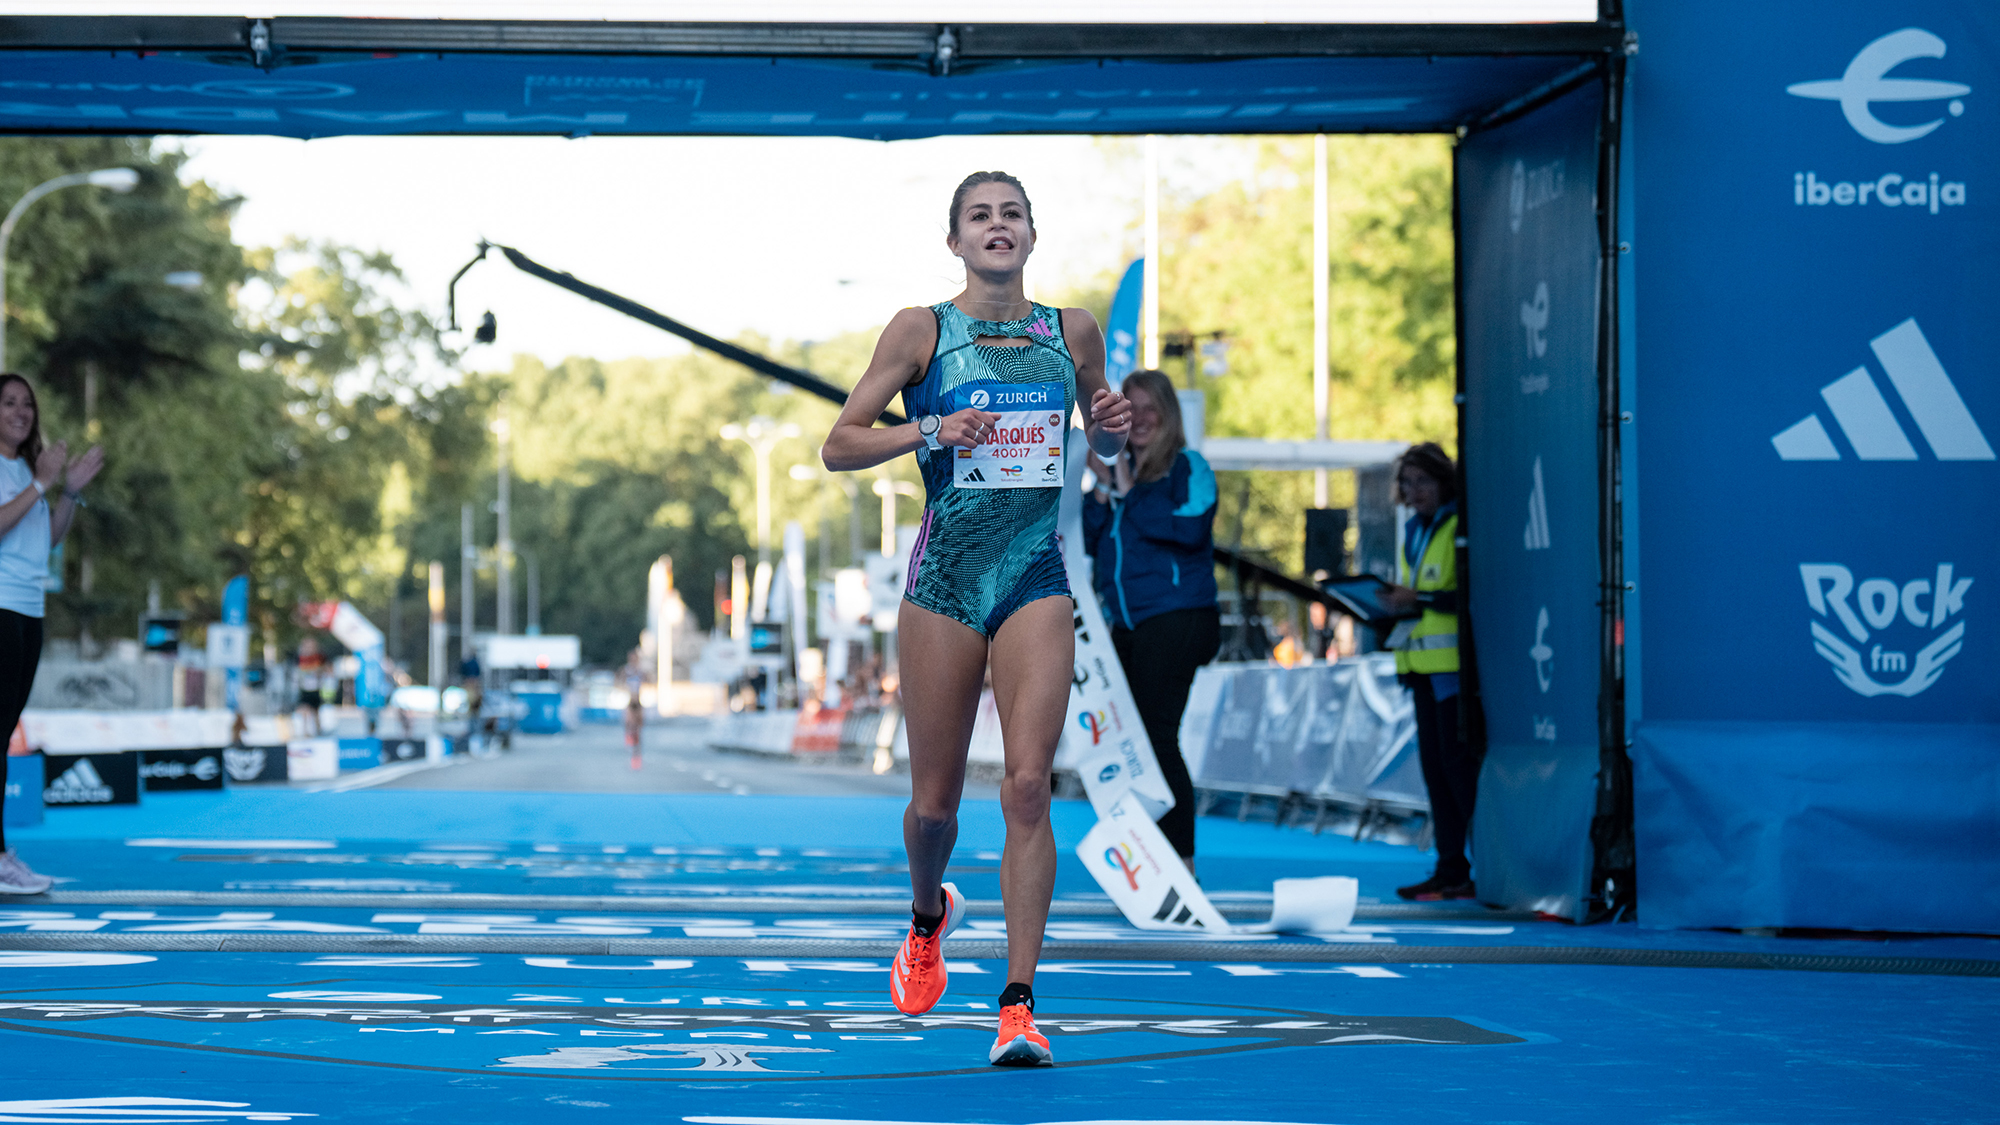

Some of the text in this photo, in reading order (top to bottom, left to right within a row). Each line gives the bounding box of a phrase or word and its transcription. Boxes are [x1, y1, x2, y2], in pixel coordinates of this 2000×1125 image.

[1794, 172, 1966, 215] iberCaja
[996, 391, 1048, 405] ZURICH
[991, 447, 1031, 459] 40017
[1798, 563, 1974, 644] Rock
[1870, 645, 1907, 673] fm
[358, 1027, 924, 1042] MADRID
